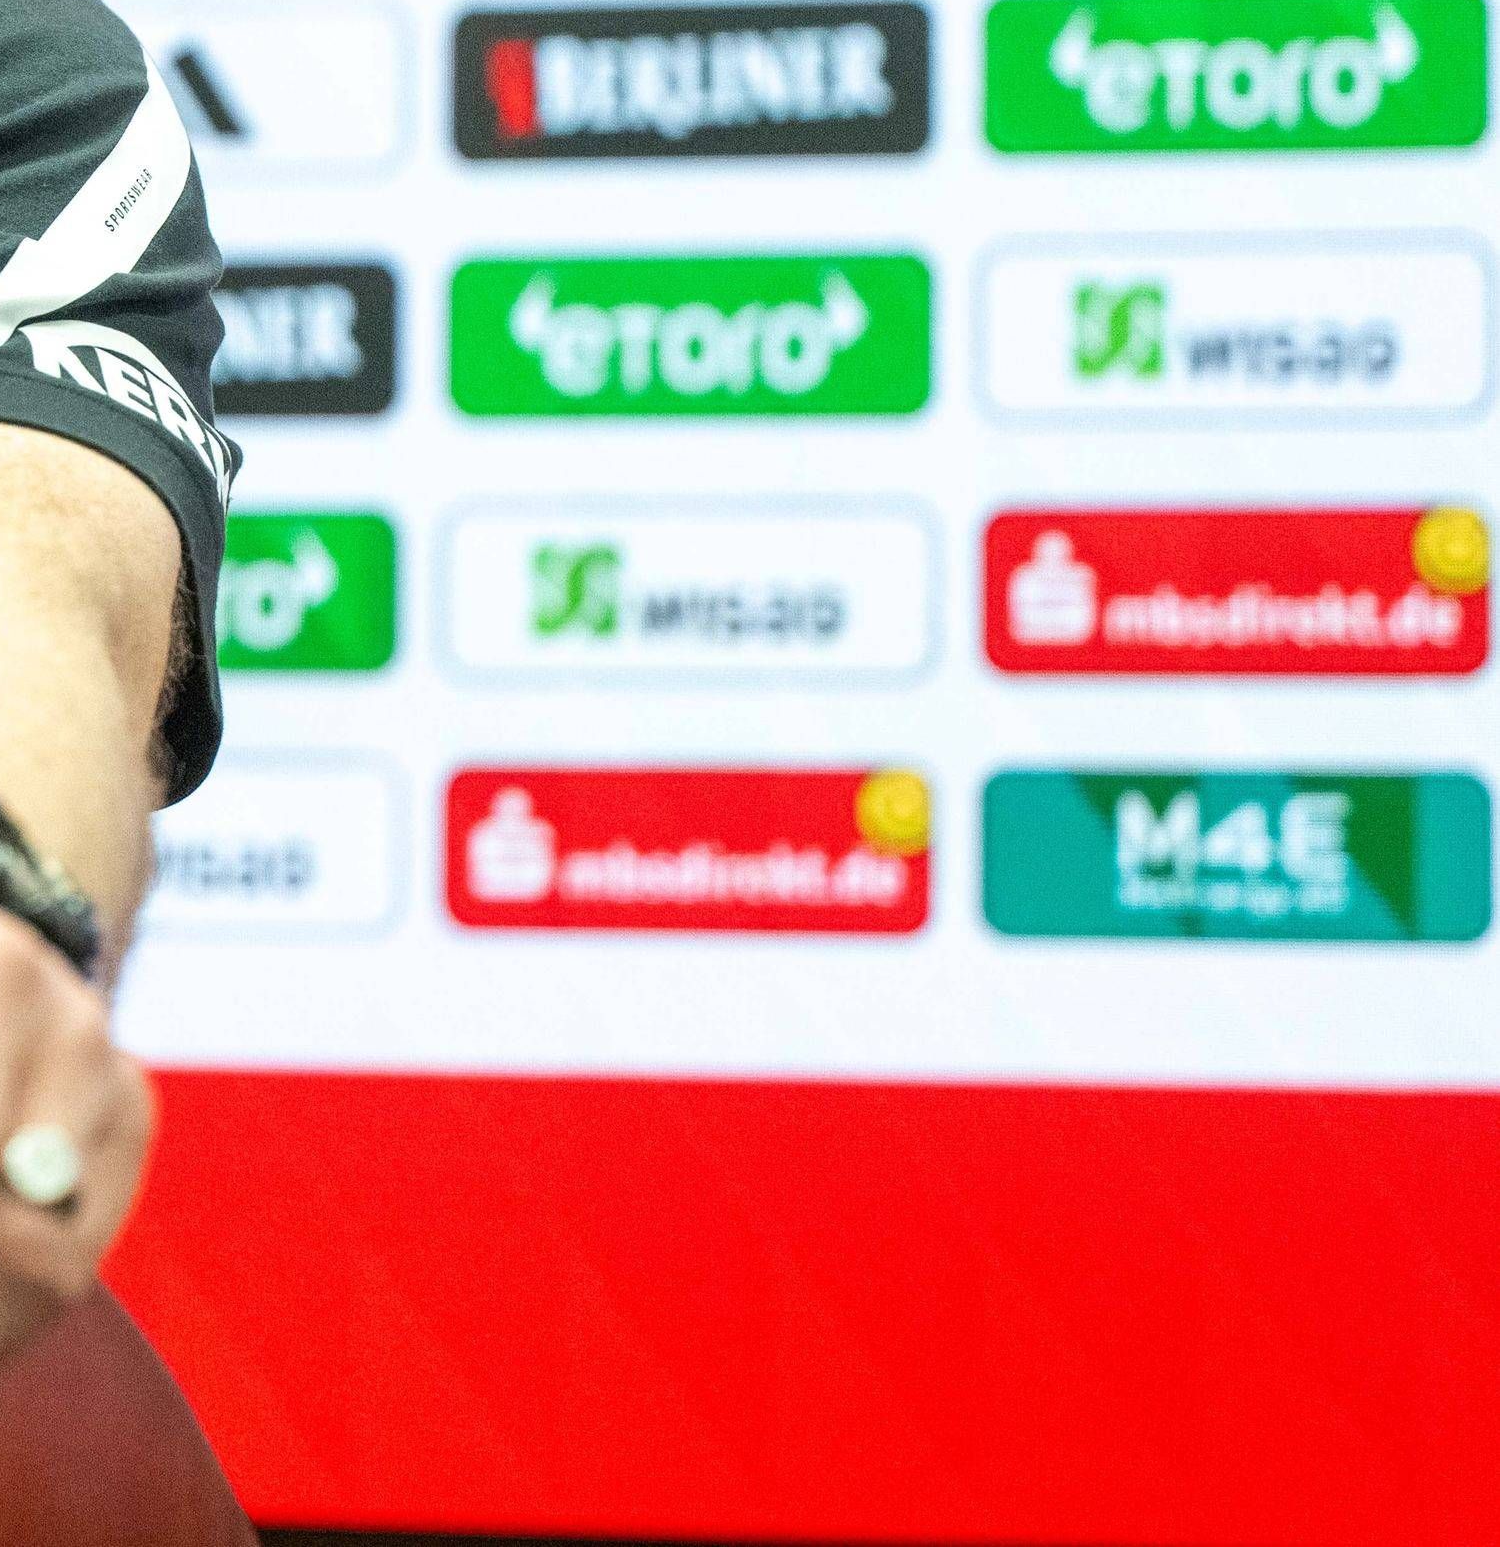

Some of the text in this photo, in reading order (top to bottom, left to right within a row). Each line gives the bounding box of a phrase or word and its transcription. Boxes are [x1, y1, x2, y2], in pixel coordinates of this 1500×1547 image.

[537, 22, 897, 148] BERLINER
[104, 167, 153, 233] SPORTSWEAR
[1115, 788, 1352, 873] M4E
